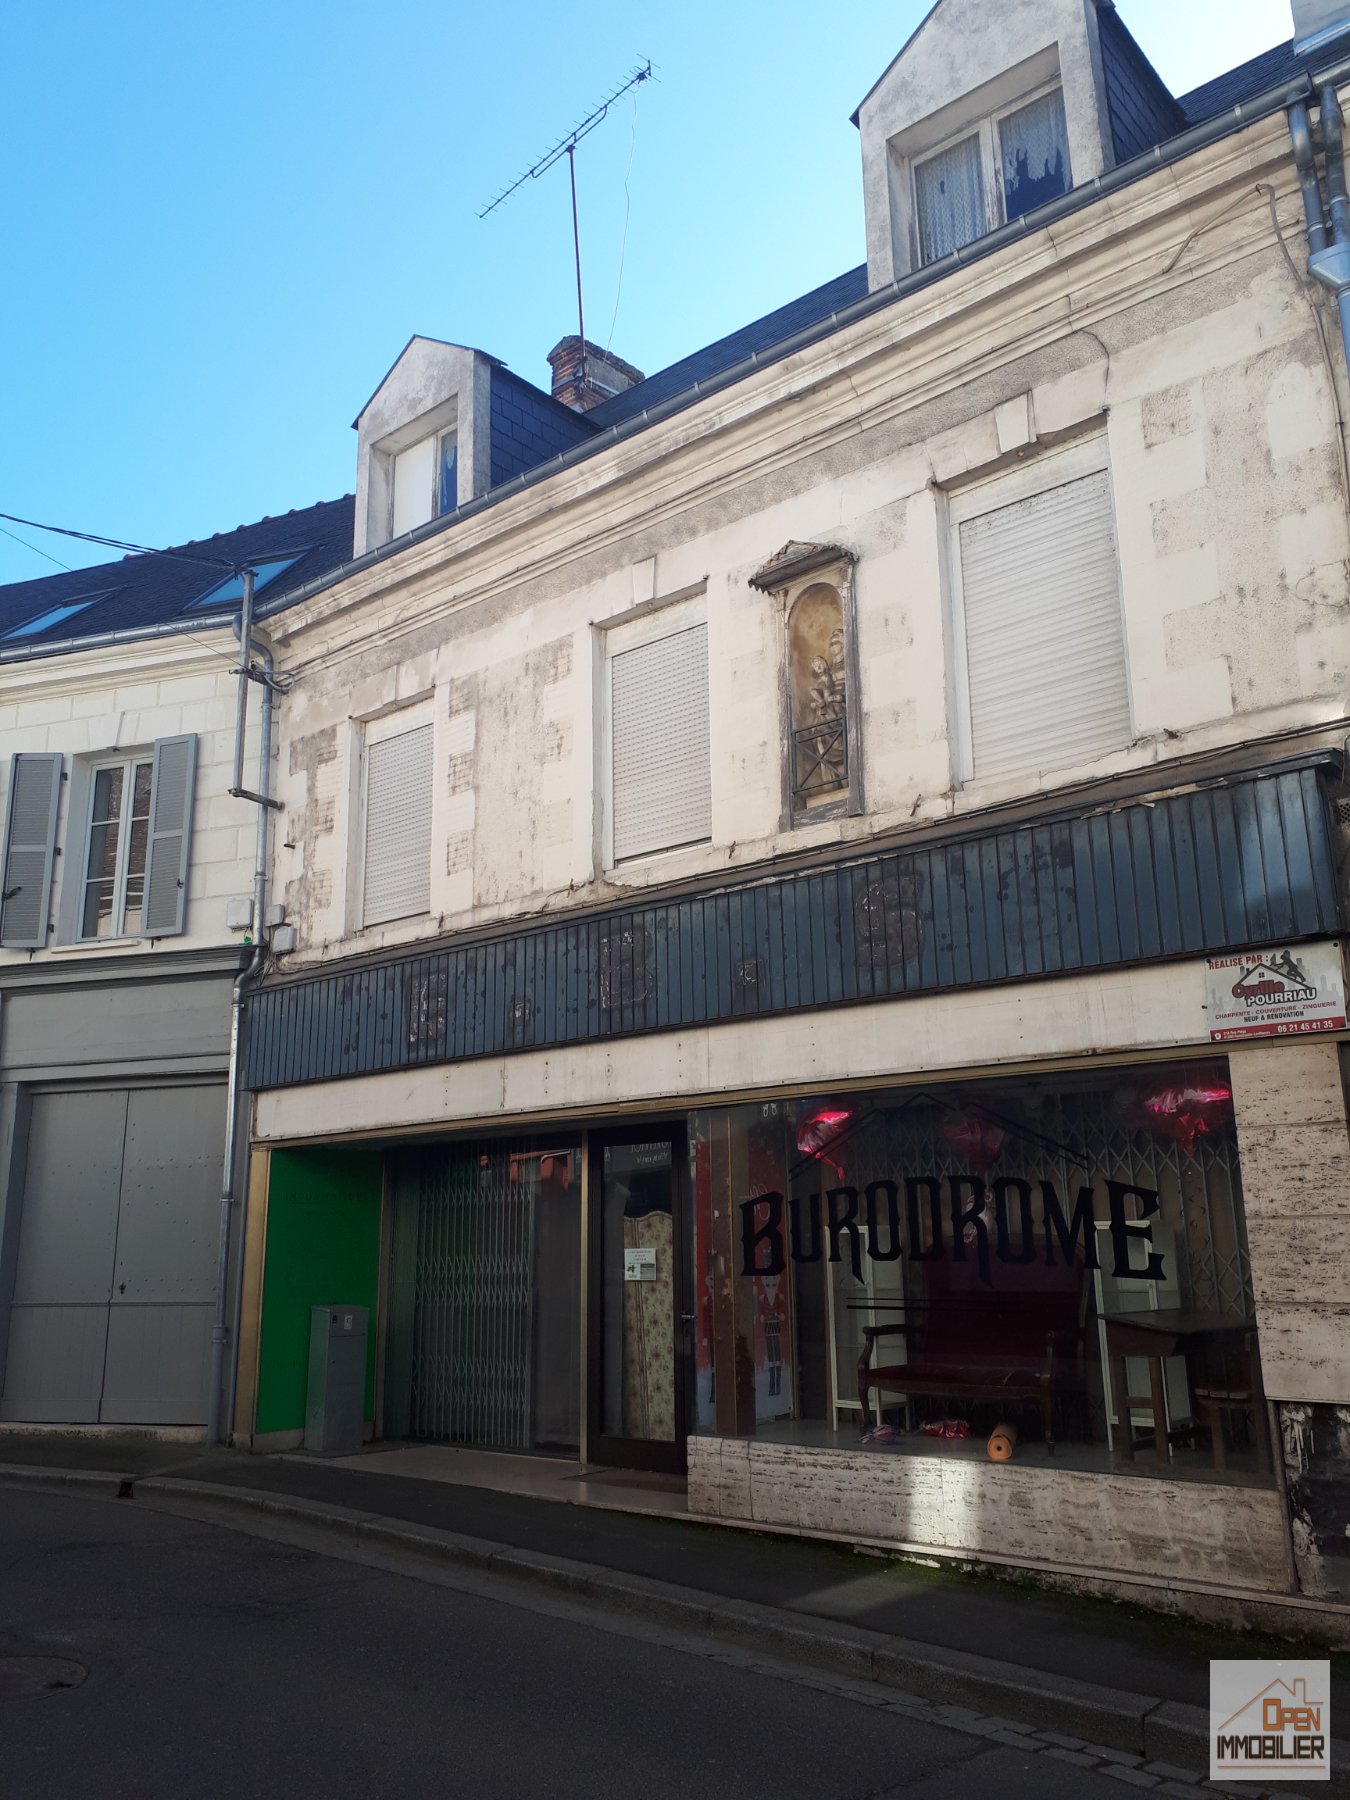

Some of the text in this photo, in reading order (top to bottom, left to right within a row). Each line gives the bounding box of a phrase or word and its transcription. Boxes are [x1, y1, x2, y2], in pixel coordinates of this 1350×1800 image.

[1245, 954, 1263, 965] PAR
[1246, 988, 1317, 1007] POURRIAU
[1215, 1011, 1251, 1020] CHARPENTE
[1255, 1006, 1297, 1015] COUVERTURE
[1302, 1001, 1337, 1010] ZINGUERIE
[1244, 1015, 1259, 1023] NEUF
[1277, 1020, 1334, 1033] 06 21 45 41 35
[738, 1174, 1168, 1289] BURODROME
